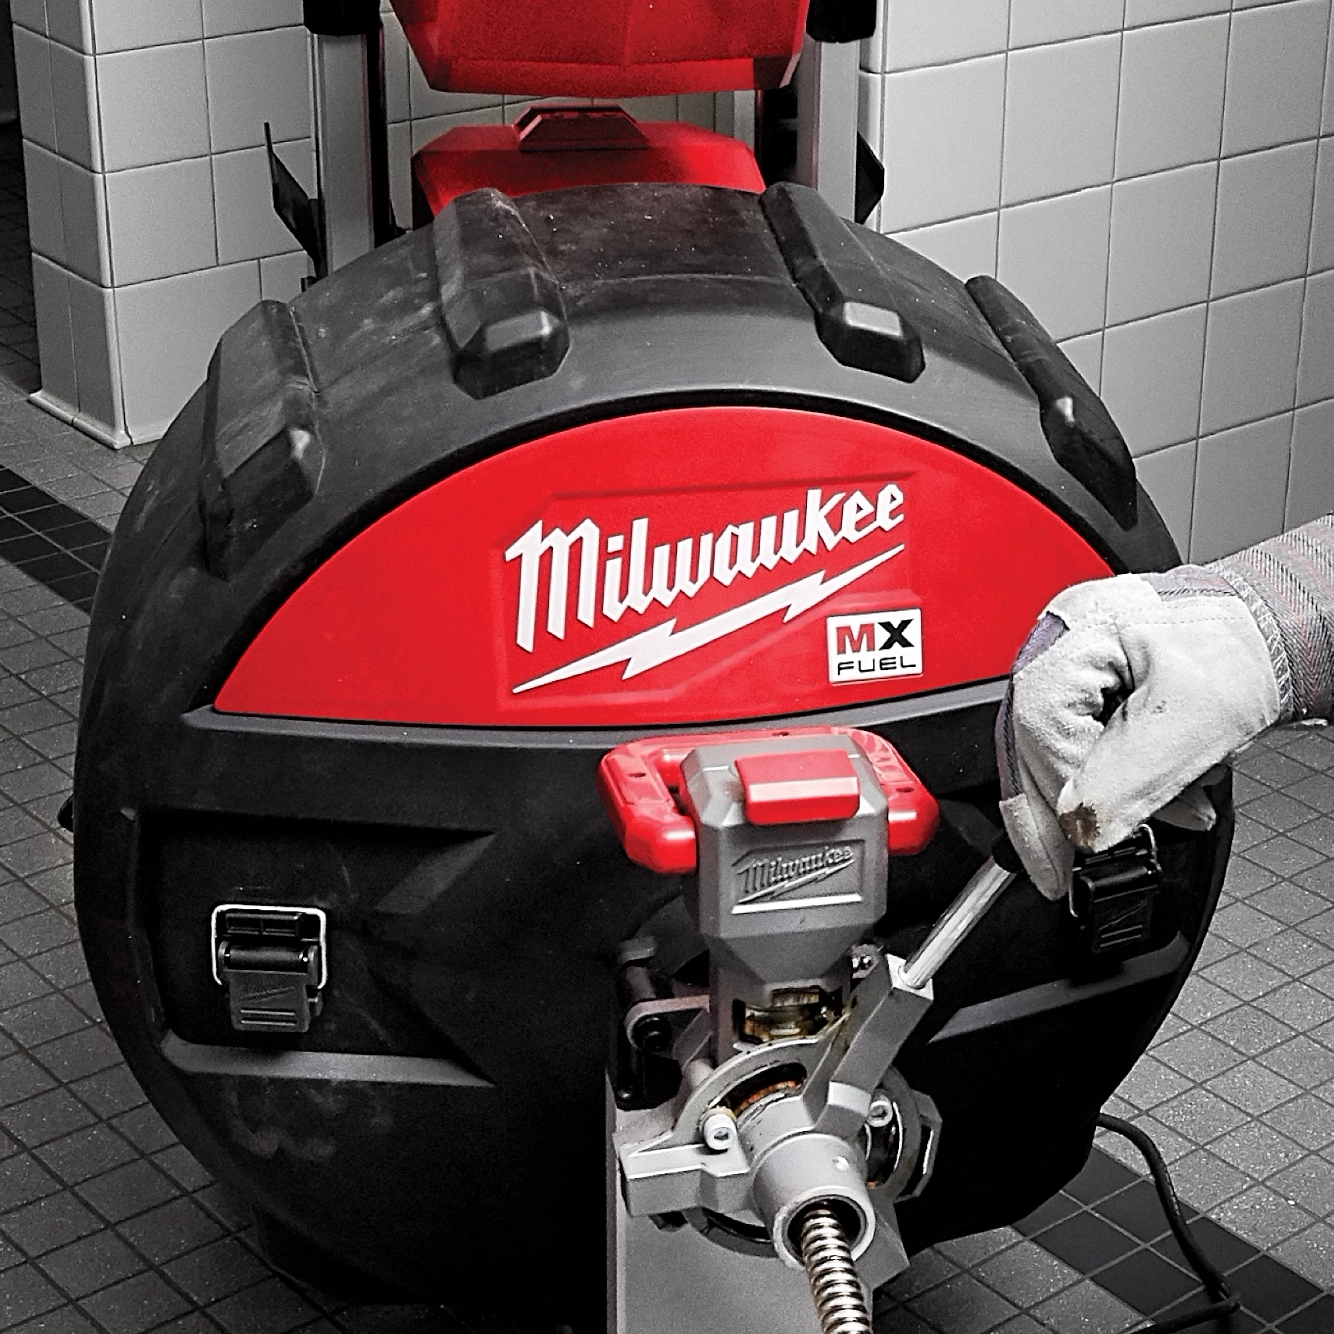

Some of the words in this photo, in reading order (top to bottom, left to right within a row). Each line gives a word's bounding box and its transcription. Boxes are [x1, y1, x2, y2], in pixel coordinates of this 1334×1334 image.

[505, 483, 904, 653] Milwaukee
[836, 619, 915, 655] MX
[837, 656, 916, 676] FUEL
[737, 846, 853, 893] Milwaukee
